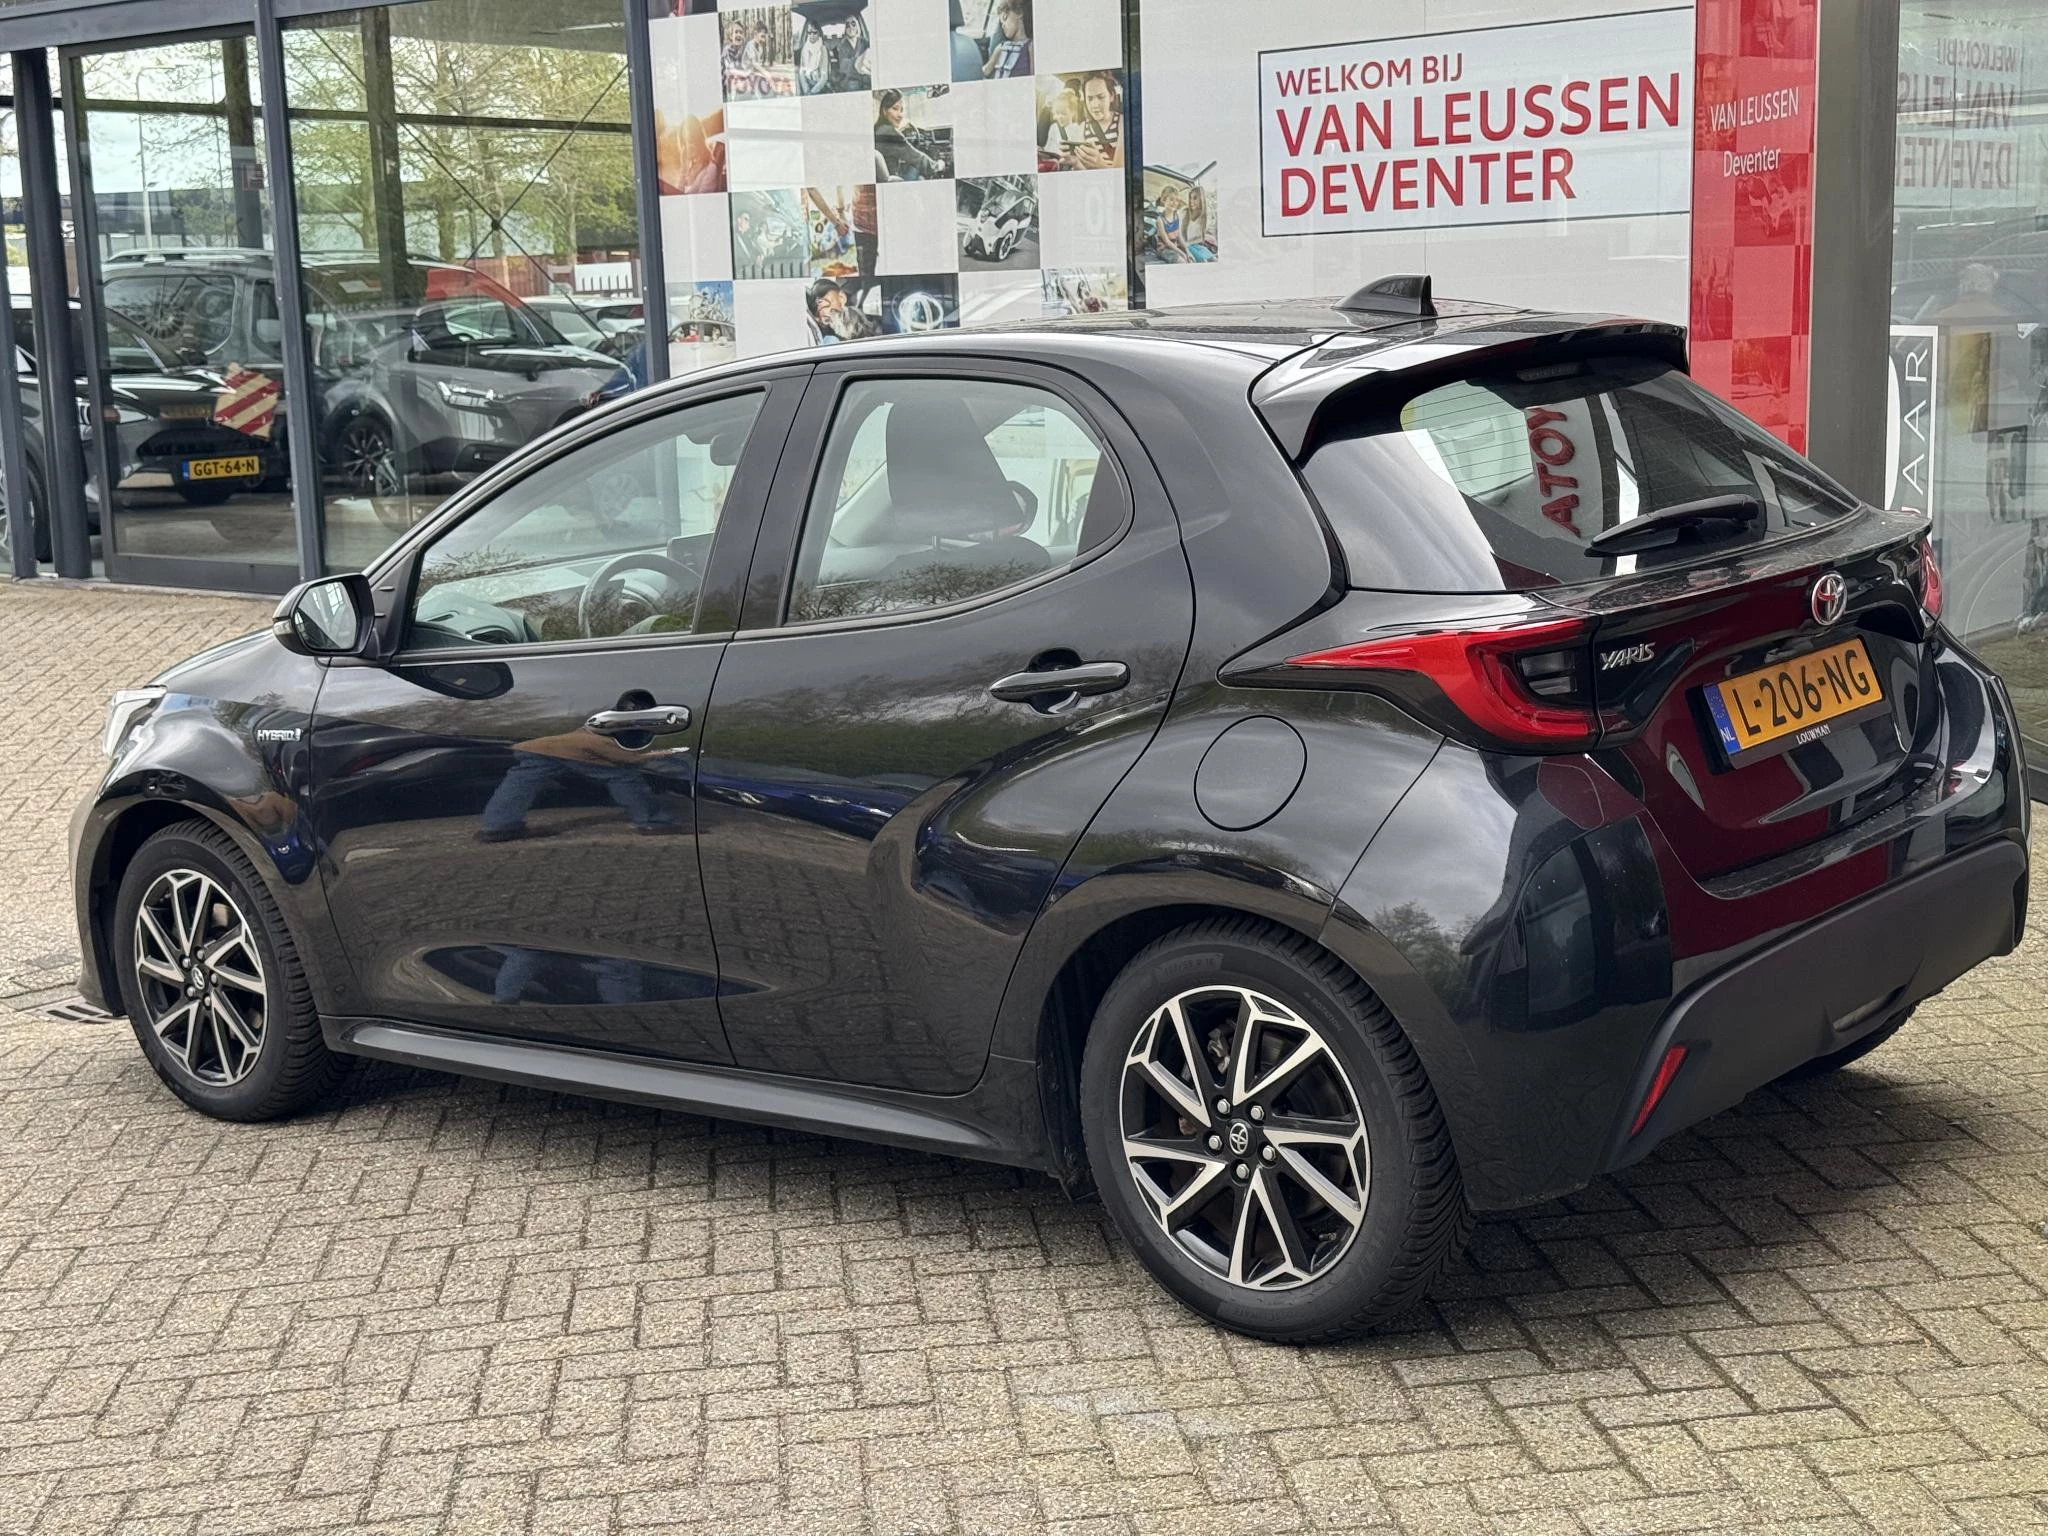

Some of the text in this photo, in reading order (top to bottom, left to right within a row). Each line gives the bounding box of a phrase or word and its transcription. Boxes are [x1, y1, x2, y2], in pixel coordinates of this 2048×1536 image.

[1276, 53, 1463, 97] WELKOM BIJ
[1276, 72, 1680, 157] VAN LEUSSEN
[1710, 87, 1799, 132] VAN LEUSSEN
[1723, 145, 1781, 177] Deventer
[1281, 147, 1577, 217] DEVENTER
[193, 458, 256, 477] GGT-64-N
[1731, 649, 1871, 737] L-206-NG
[257, 729, 295, 741] HYBRID
[1720, 728, 1736, 744] NL
[1796, 723, 1832, 745] LOUWMAN
